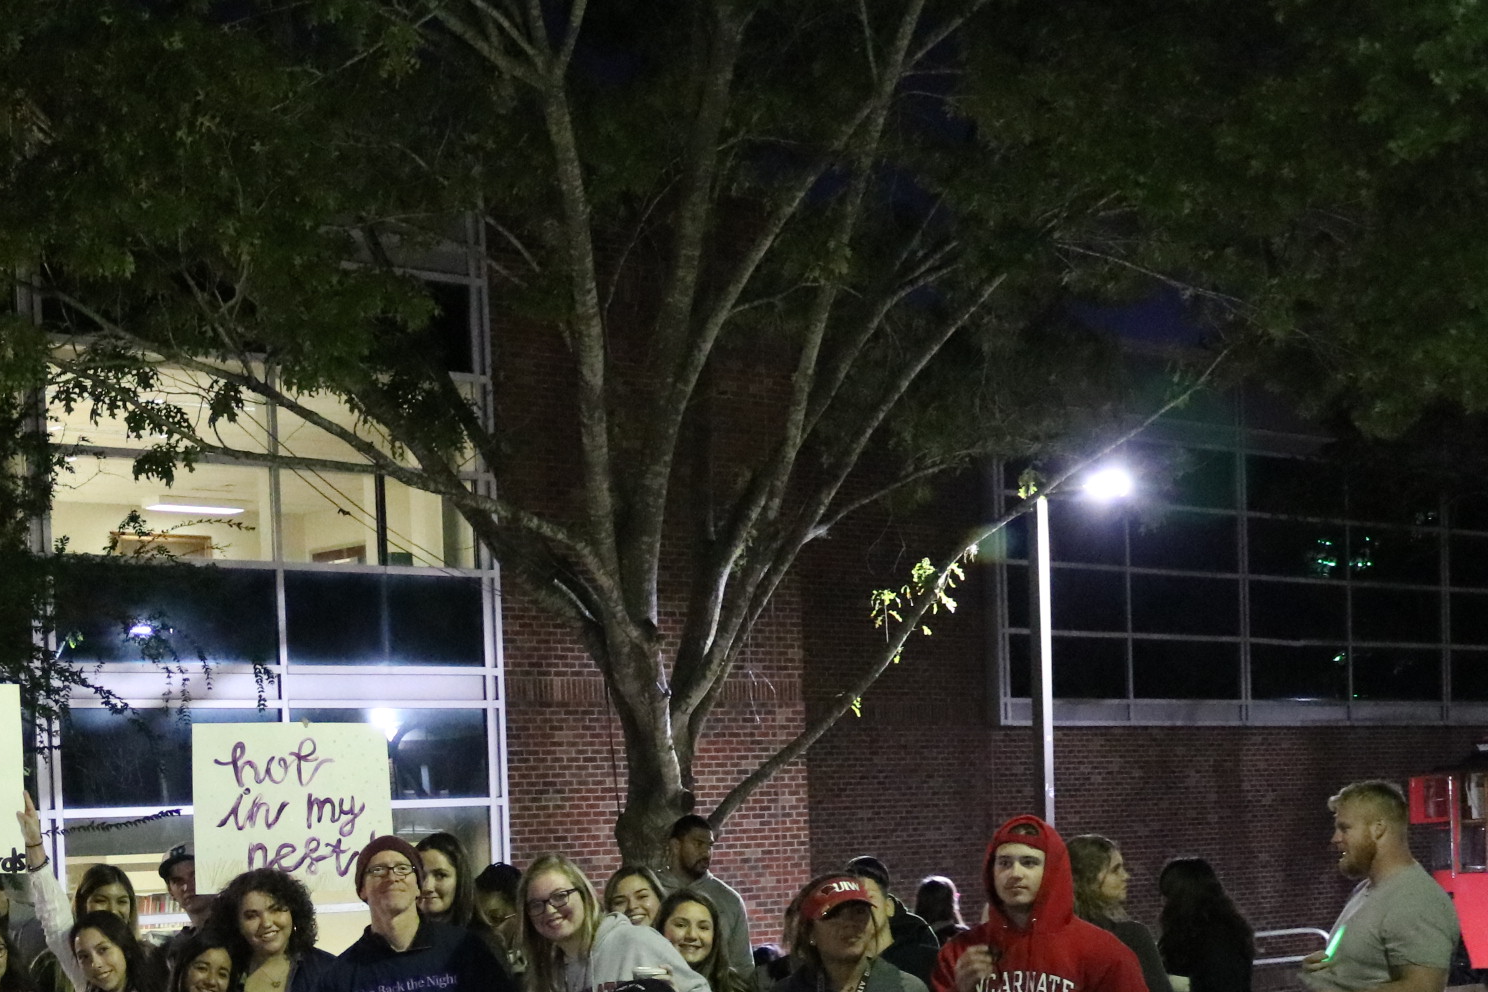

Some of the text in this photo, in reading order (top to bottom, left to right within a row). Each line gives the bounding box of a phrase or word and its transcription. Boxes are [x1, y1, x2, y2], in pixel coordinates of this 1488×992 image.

[216, 787, 366, 837] in my
[832, 881, 861, 893] UIW
[407, 977, 426, 991] the
[426, 973, 458, 989] Night
